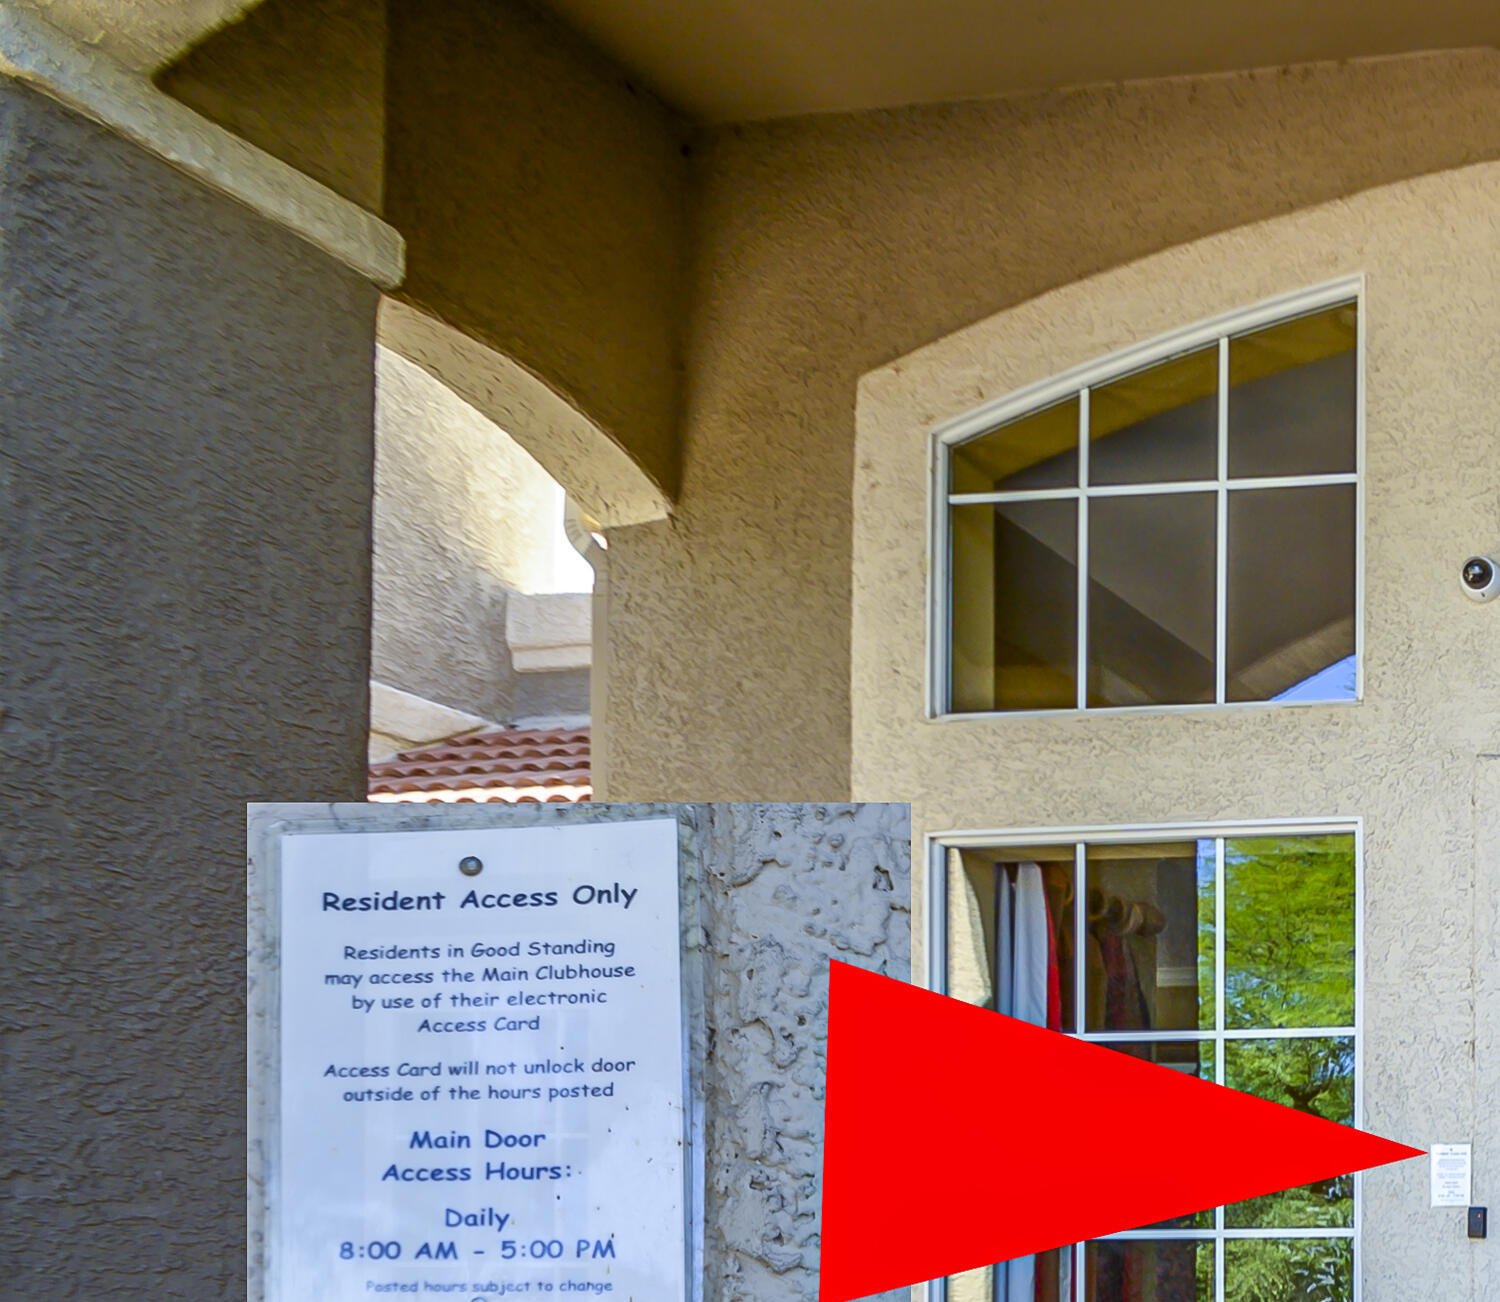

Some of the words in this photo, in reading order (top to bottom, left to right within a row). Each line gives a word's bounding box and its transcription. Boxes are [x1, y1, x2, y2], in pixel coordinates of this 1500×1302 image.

[322, 890, 446, 912] Resident
[459, 890, 559, 910] Access
[572, 882, 638, 910] Only
[344, 944, 441, 961] Residents
[447, 944, 464, 959] in
[471, 942, 521, 958] Good
[528, 939, 616, 958] Standing
[324, 974, 363, 989] may
[369, 970, 434, 985] access
[442, 968, 475, 983] the
[481, 967, 530, 982] Main
[535, 964, 636, 981] Clubhouse
[352, 995, 375, 1013] by
[381, 996, 416, 1010] use
[421, 993, 443, 1009] of
[450, 992, 500, 1008] their
[506, 989, 608, 1006] electronic
[417, 1018, 488, 1033] Access
[494, 1015, 541, 1032] Card
[323, 1064, 390, 1079] Access
[397, 1062, 442, 1077] Card
[447, 1061, 480, 1076] will
[485, 1061, 517, 1076] not
[523, 1059, 585, 1075] unlock
[591, 1057, 637, 1073] door
[343, 1087, 414, 1103] outside
[419, 1085, 442, 1101] of
[449, 1086, 482, 1101] the
[487, 1085, 542, 1100] hours
[548, 1082, 615, 1103] posted
[409, 1130, 472, 1150] Main
[484, 1129, 547, 1149] Door
[381, 1164, 472, 1182] Access
[485, 1161, 572, 1181] Hours:
[444, 1207, 511, 1232] Daily
[338, 1241, 402, 1260] 8:00
[414, 1241, 459, 1260] AM
[500, 1240, 564, 1260] 5:00
[575, 1239, 617, 1259] PM
[365, 1281, 419, 1294] Posted
[423, 1281, 468, 1293] hours
[472, 1280, 531, 1296] subject
[537, 1280, 554, 1292] to
[559, 1280, 614, 1293] change
